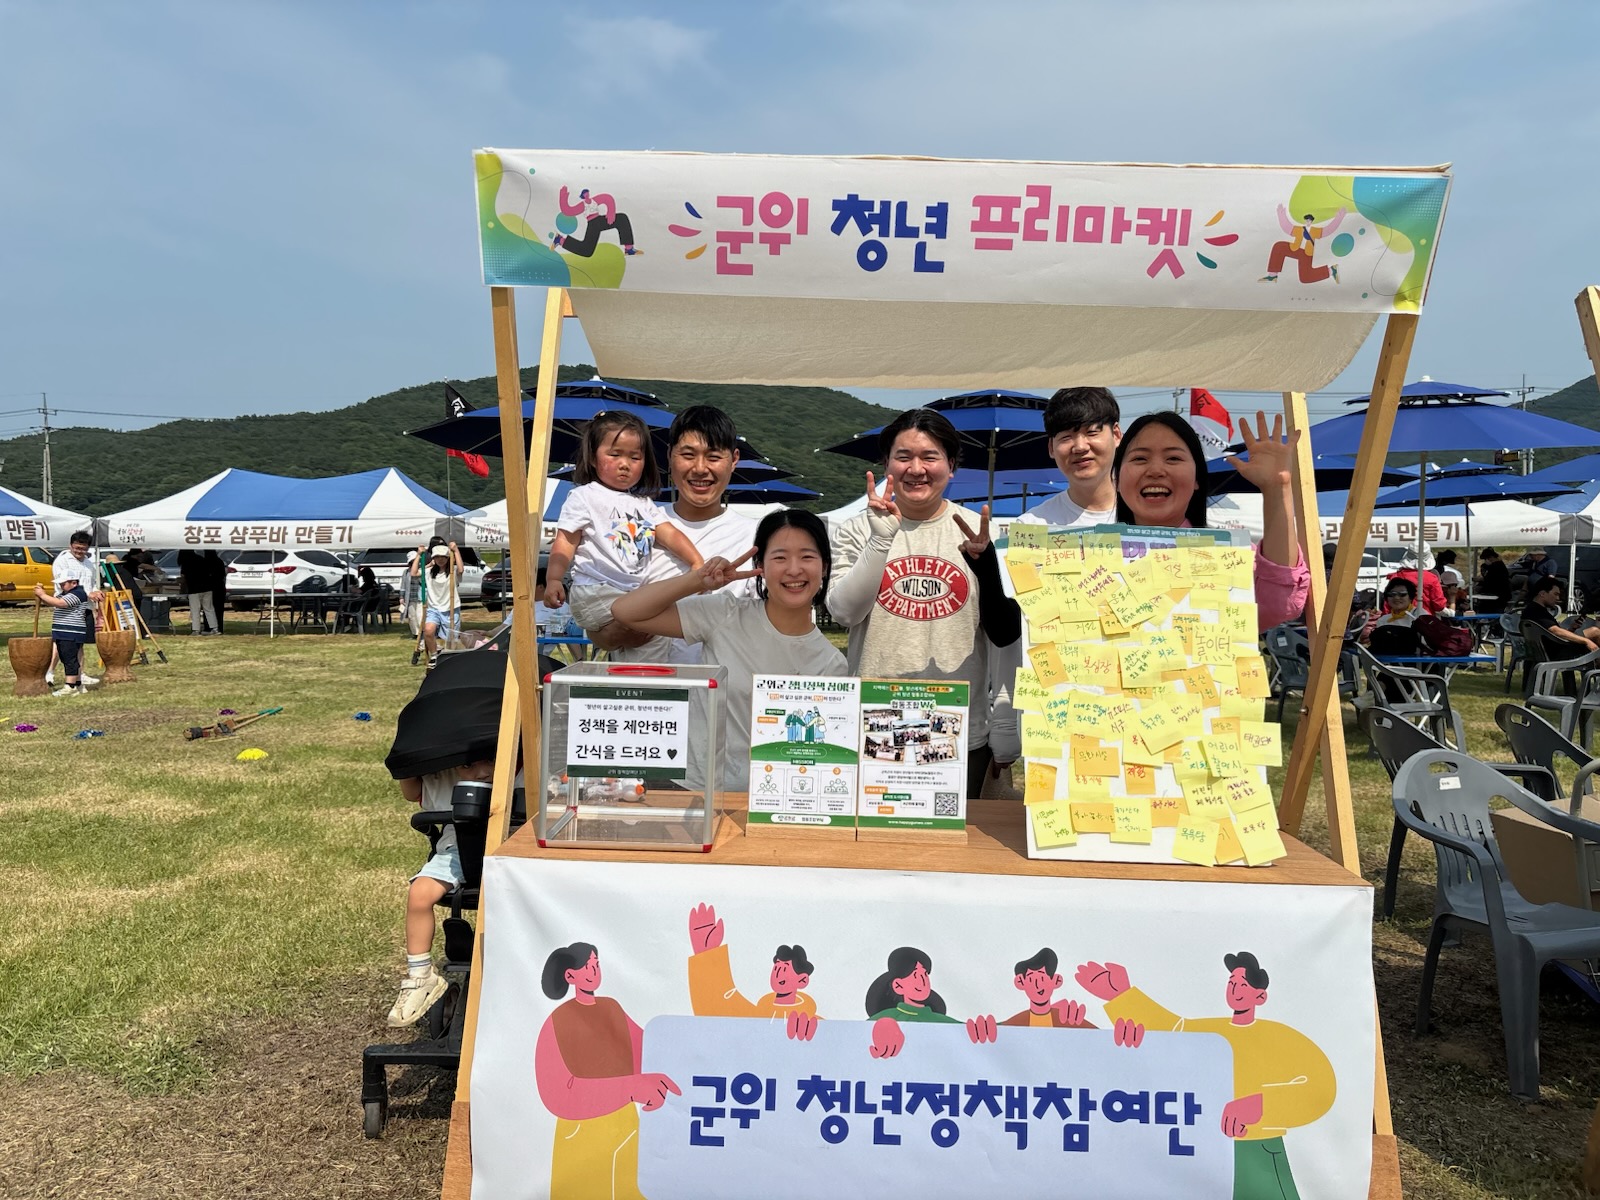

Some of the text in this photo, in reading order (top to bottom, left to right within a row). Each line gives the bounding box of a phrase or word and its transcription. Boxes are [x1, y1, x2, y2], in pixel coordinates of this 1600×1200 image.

[716, 184, 1192, 281] 군위 청년 프리마켓
[6, 520, 50, 541] 만들기
[184, 525, 354, 545] 창포 샴푸바 만들기
[1397, 522, 1460, 542] 만들기
[885, 558, 961, 583] ATHLETIC
[902, 579, 942, 597] WILSON
[878, 587, 962, 619] DEPARTMENT
[1195, 632, 1231, 656] 놀이터
[578, 719, 677, 736] 정책을 제안하면
[575, 744, 662, 761] 간식을 드려요
[690, 1072, 1203, 1156] 군위 청년정책참여단
